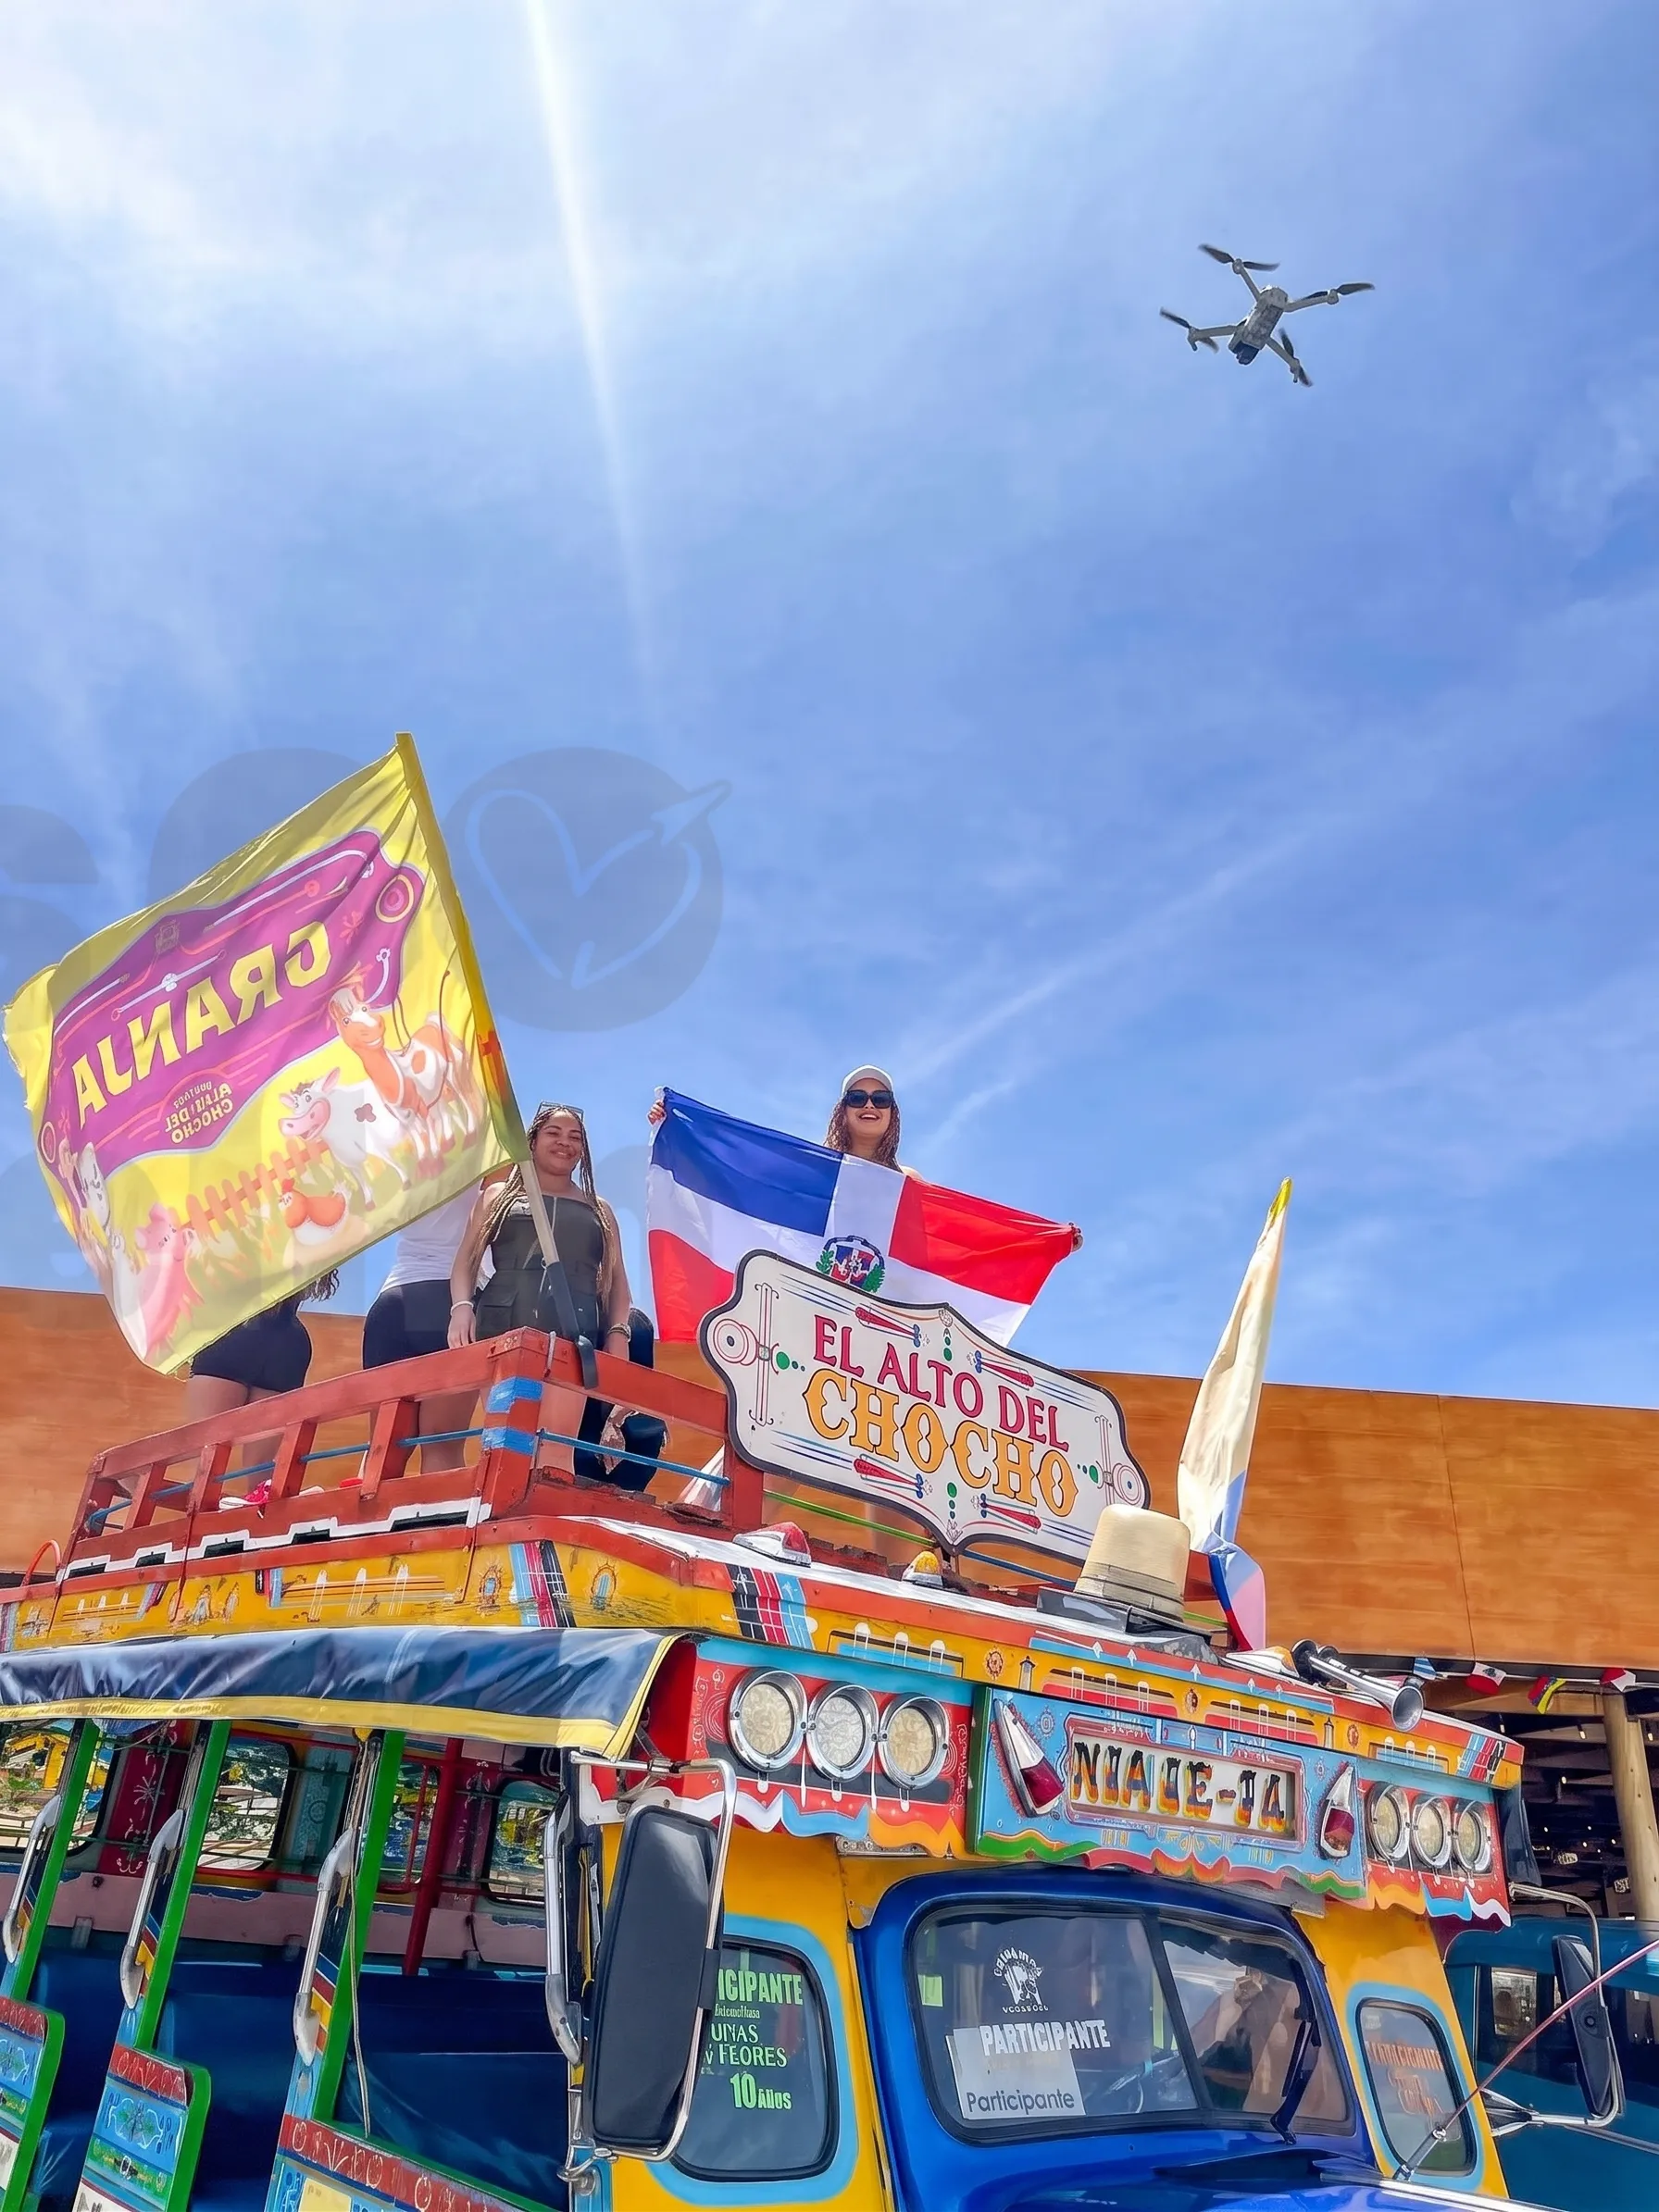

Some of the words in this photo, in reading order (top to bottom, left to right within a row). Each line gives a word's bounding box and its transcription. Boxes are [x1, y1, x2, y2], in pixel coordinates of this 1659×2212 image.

[813, 1314, 865, 1378] EL
[877, 1341, 984, 1419] ALTO
[997, 1385, 1069, 1453] DEL
[802, 1367, 1080, 1518] CHOCHO
[717, 1969, 803, 2006] ICIPANTE
[979, 2019, 1111, 2057] PARTICIPANTE
[730, 2072, 757, 2109] 10
[966, 2088, 1075, 2115] Participante
